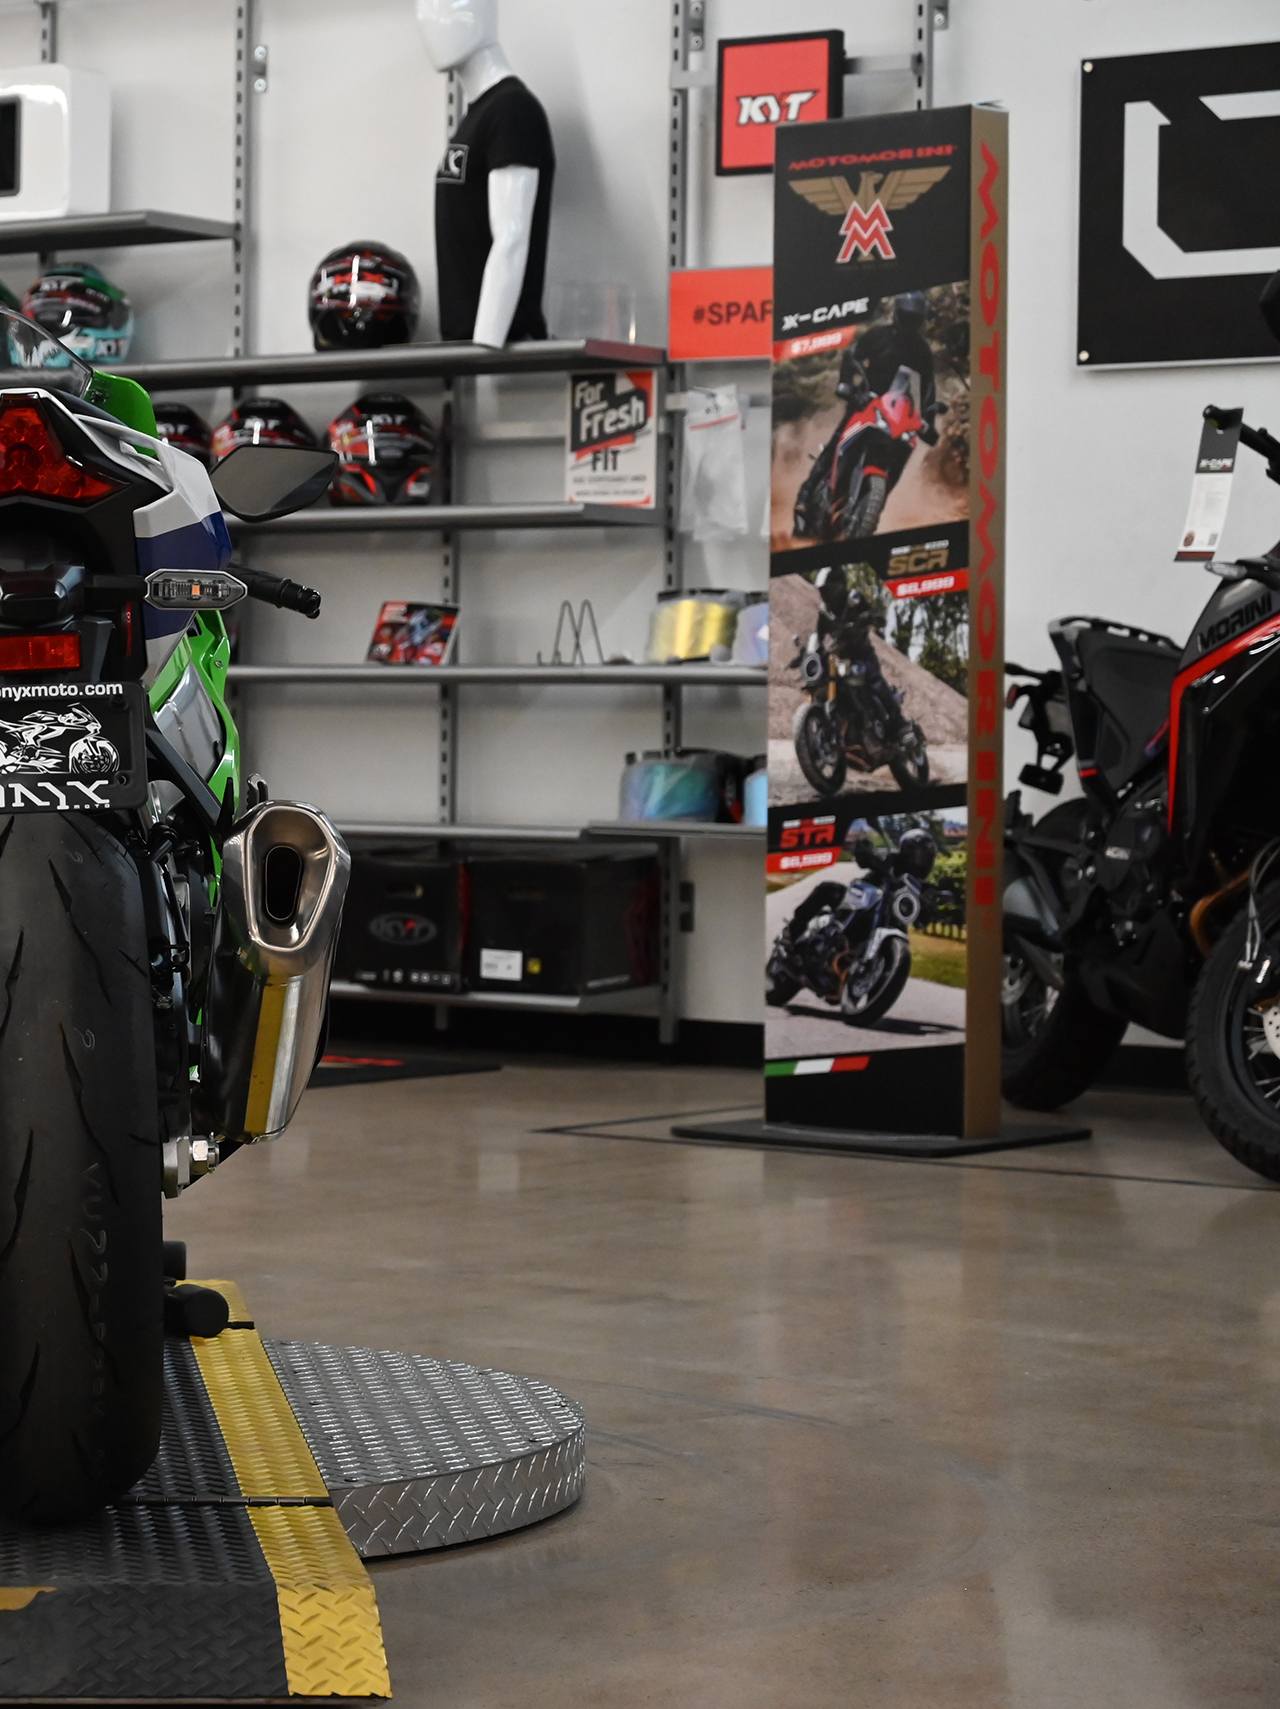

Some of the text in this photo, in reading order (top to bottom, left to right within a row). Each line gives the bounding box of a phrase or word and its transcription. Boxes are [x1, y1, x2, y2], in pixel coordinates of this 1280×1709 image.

[736, 89, 819, 126] KYT
[788, 144, 954, 170] MOTOMORINI
[781, 296, 870, 332] X-CAPE
[574, 380, 605, 409] For
[580, 395, 645, 442] Fresh
[592, 447, 620, 472] FIT
[1199, 596, 1274, 650] MORINI
